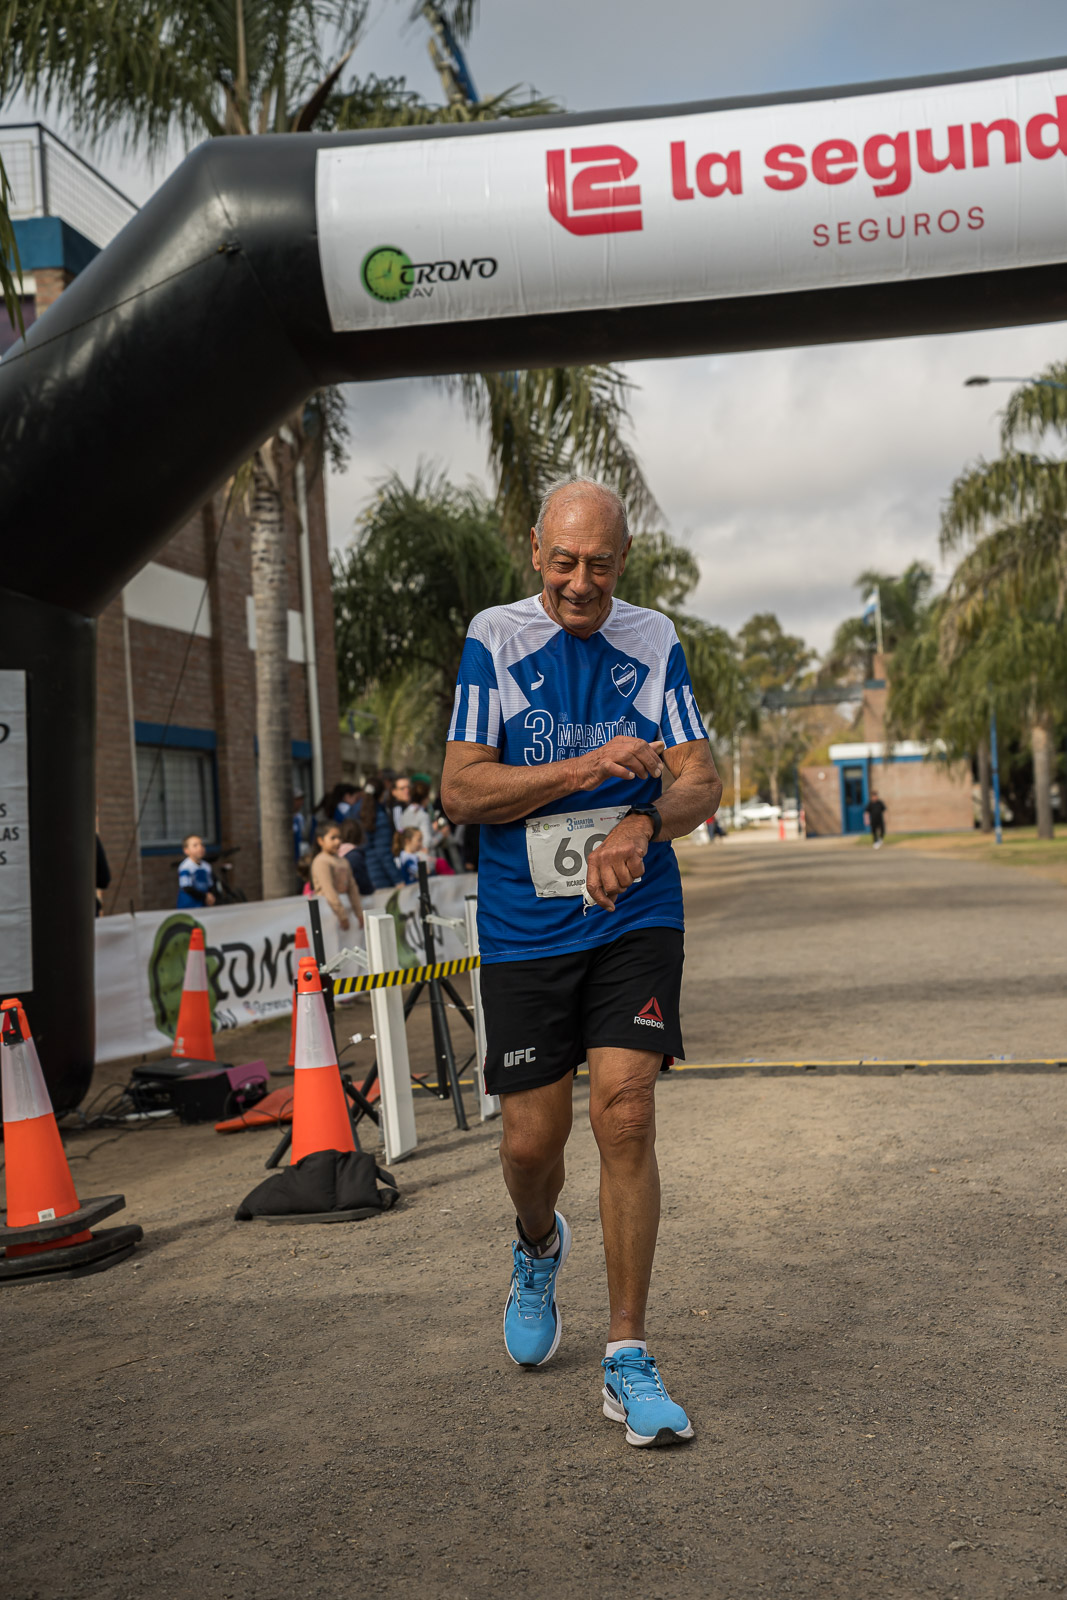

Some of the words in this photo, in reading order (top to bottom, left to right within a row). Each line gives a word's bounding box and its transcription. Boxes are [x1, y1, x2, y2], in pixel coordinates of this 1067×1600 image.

[670, 140, 743, 203] la
[813, 206, 986, 248] SEGUROS
[400, 257, 498, 286] CRONO
[523, 709, 554, 766] 3
[557, 715, 637, 748] MARATÓN
[566, 817, 574, 832] 3
[566, 879, 585, 887] RICARDO
[634, 1015, 665, 1031] Reebok
[503, 1047, 537, 1068] UFC
